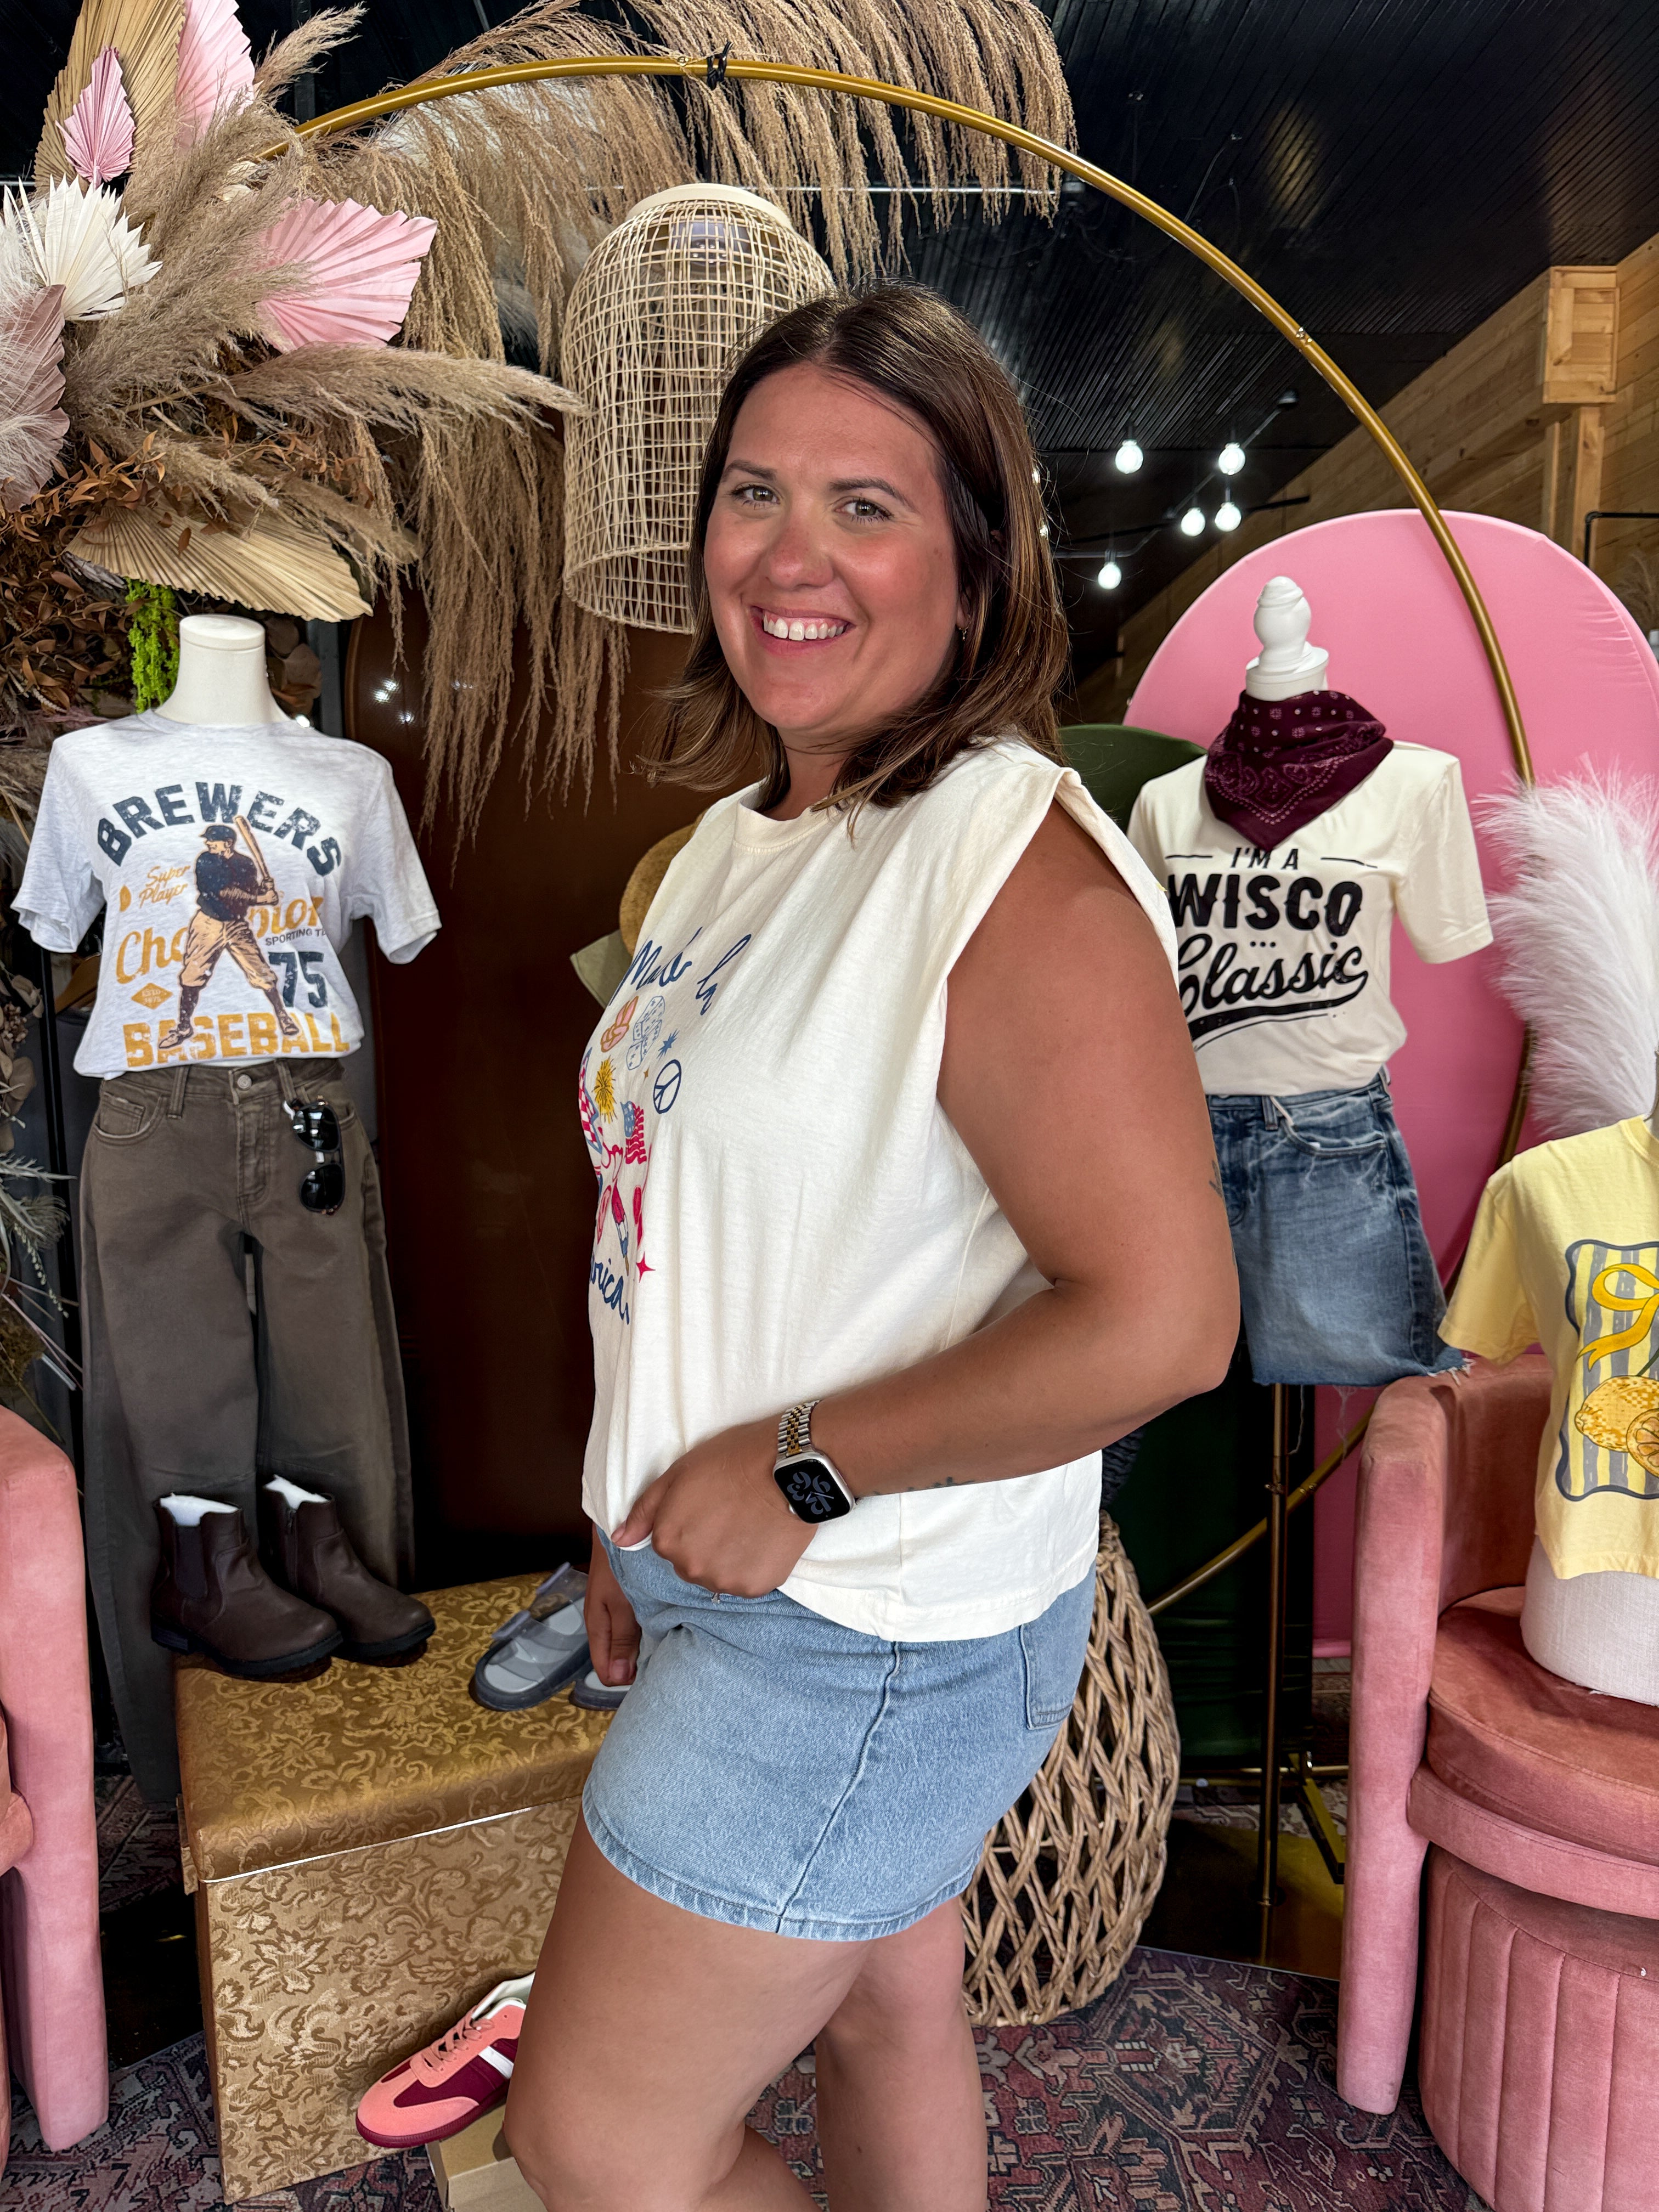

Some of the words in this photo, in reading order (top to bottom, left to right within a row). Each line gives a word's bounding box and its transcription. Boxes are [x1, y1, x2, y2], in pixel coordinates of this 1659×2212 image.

[98, 781, 342, 877] BREWERS
[145, 865, 191, 888] Super
[1231, 847, 1272, 869] I'M
[1280, 848, 1299, 870] A
[138, 883, 189, 909] Player
[1168, 873, 1363, 936] WISCO
[266, 928, 313, 951] SPORTING
[268, 951, 328, 1008] 75
[1178, 933, 1368, 1018] Classic
[123, 1012, 350, 1068] BASEBALL
